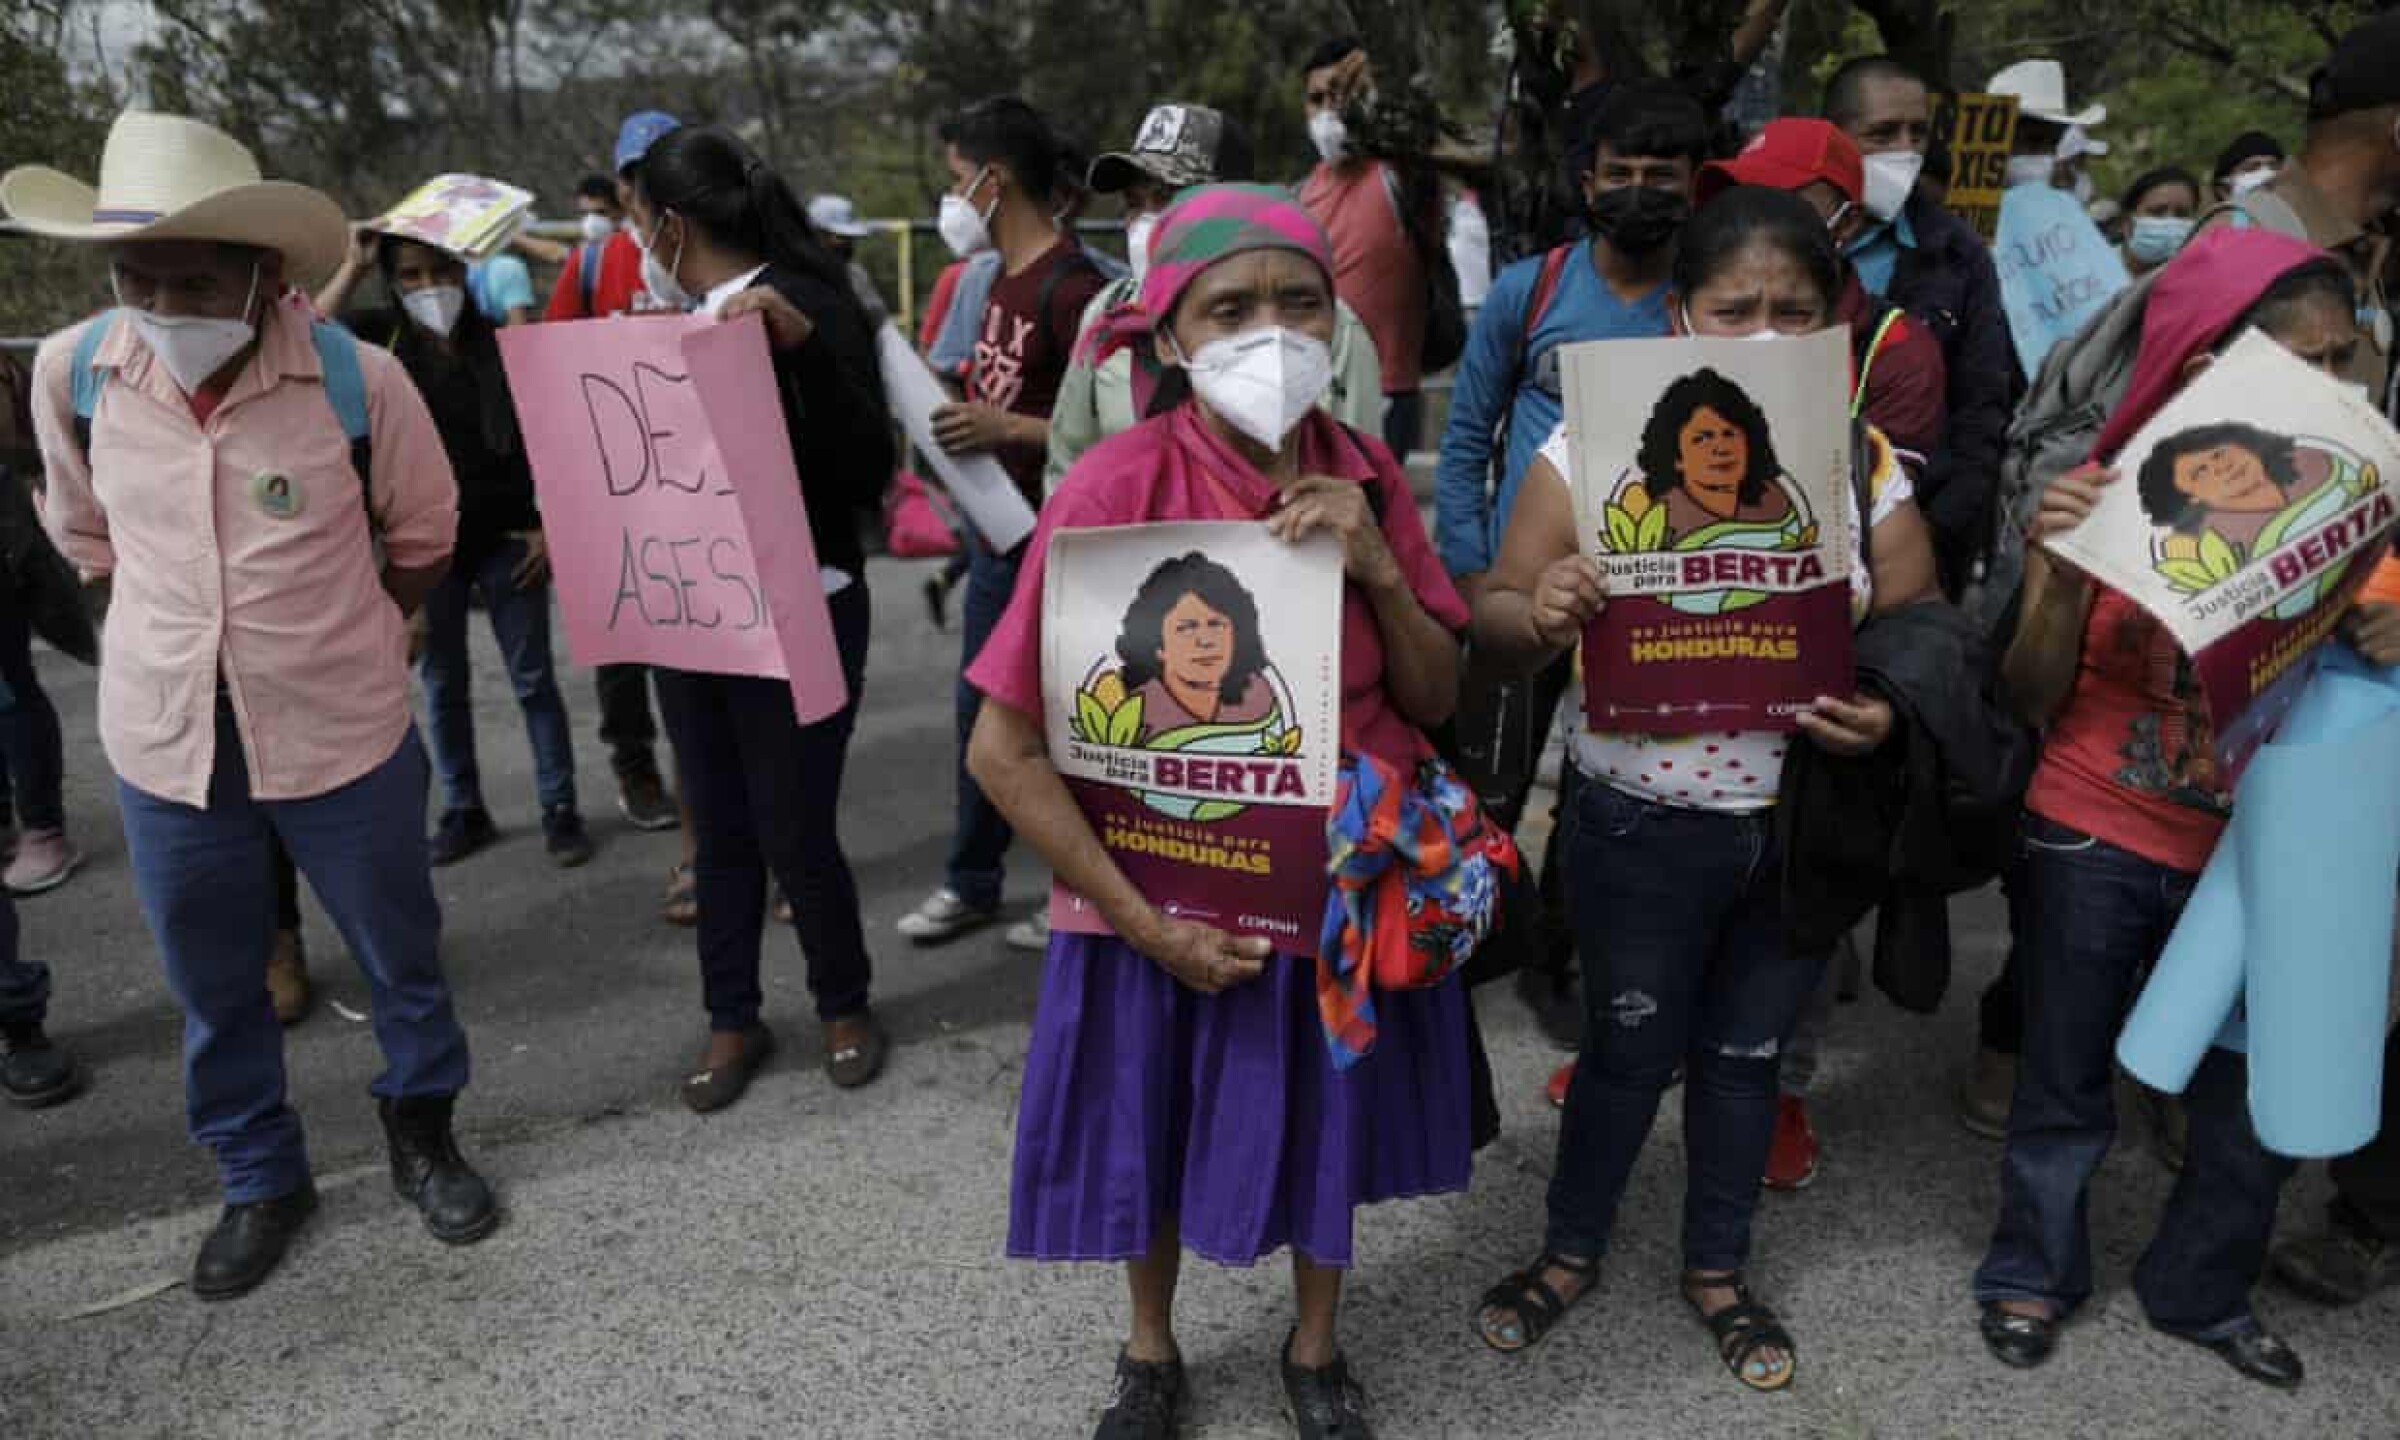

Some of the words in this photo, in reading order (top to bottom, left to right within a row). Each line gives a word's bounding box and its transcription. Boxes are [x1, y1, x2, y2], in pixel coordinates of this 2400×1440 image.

[2271, 494, 2393, 589] BERTA
[1600, 556, 1676, 576] Justicia
[1633, 573, 1676, 588] para
[1682, 553, 1824, 585] BERTA
[2189, 572, 2269, 620] Justicia
[2234, 585, 2275, 619] para
[1632, 637, 1798, 665] HONDURAS
[1069, 745, 1148, 770] Justicia
[1105, 764, 1149, 783] para
[1155, 757, 1306, 798] BERTA
[1104, 827, 1271, 874] HONDURAS
